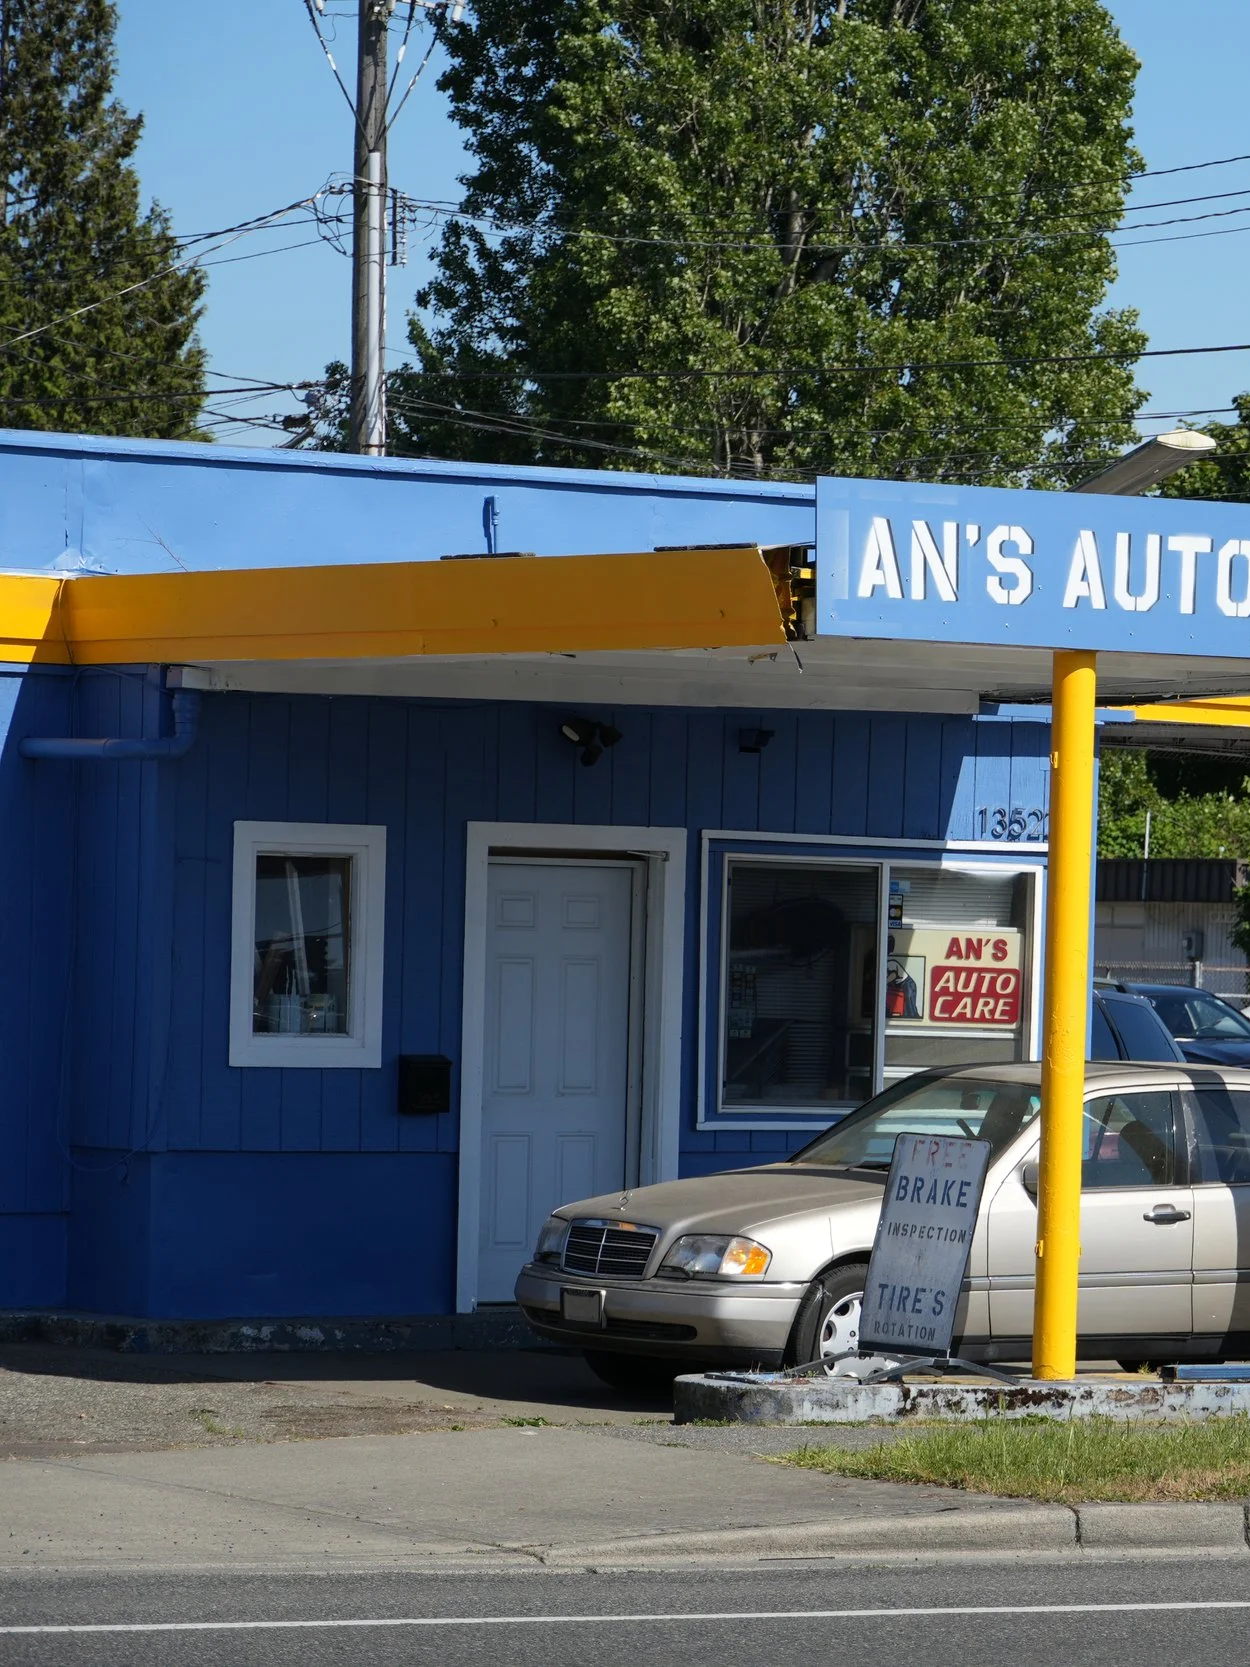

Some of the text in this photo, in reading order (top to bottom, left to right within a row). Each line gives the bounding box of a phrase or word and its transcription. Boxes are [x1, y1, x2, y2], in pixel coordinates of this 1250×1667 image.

[857, 516, 1034, 606] AN'S
[978, 807, 1049, 840] 1352
[944, 937, 1009, 962] AN'S
[934, 970, 1017, 995] AUTO
[933, 996, 1014, 1019] CARE
[911, 1139, 973, 1169] FREE
[895, 1175, 972, 1208] BRAKE
[887, 1222, 967, 1244] INSPECTION
[873, 1321, 936, 1342] ROTATION
